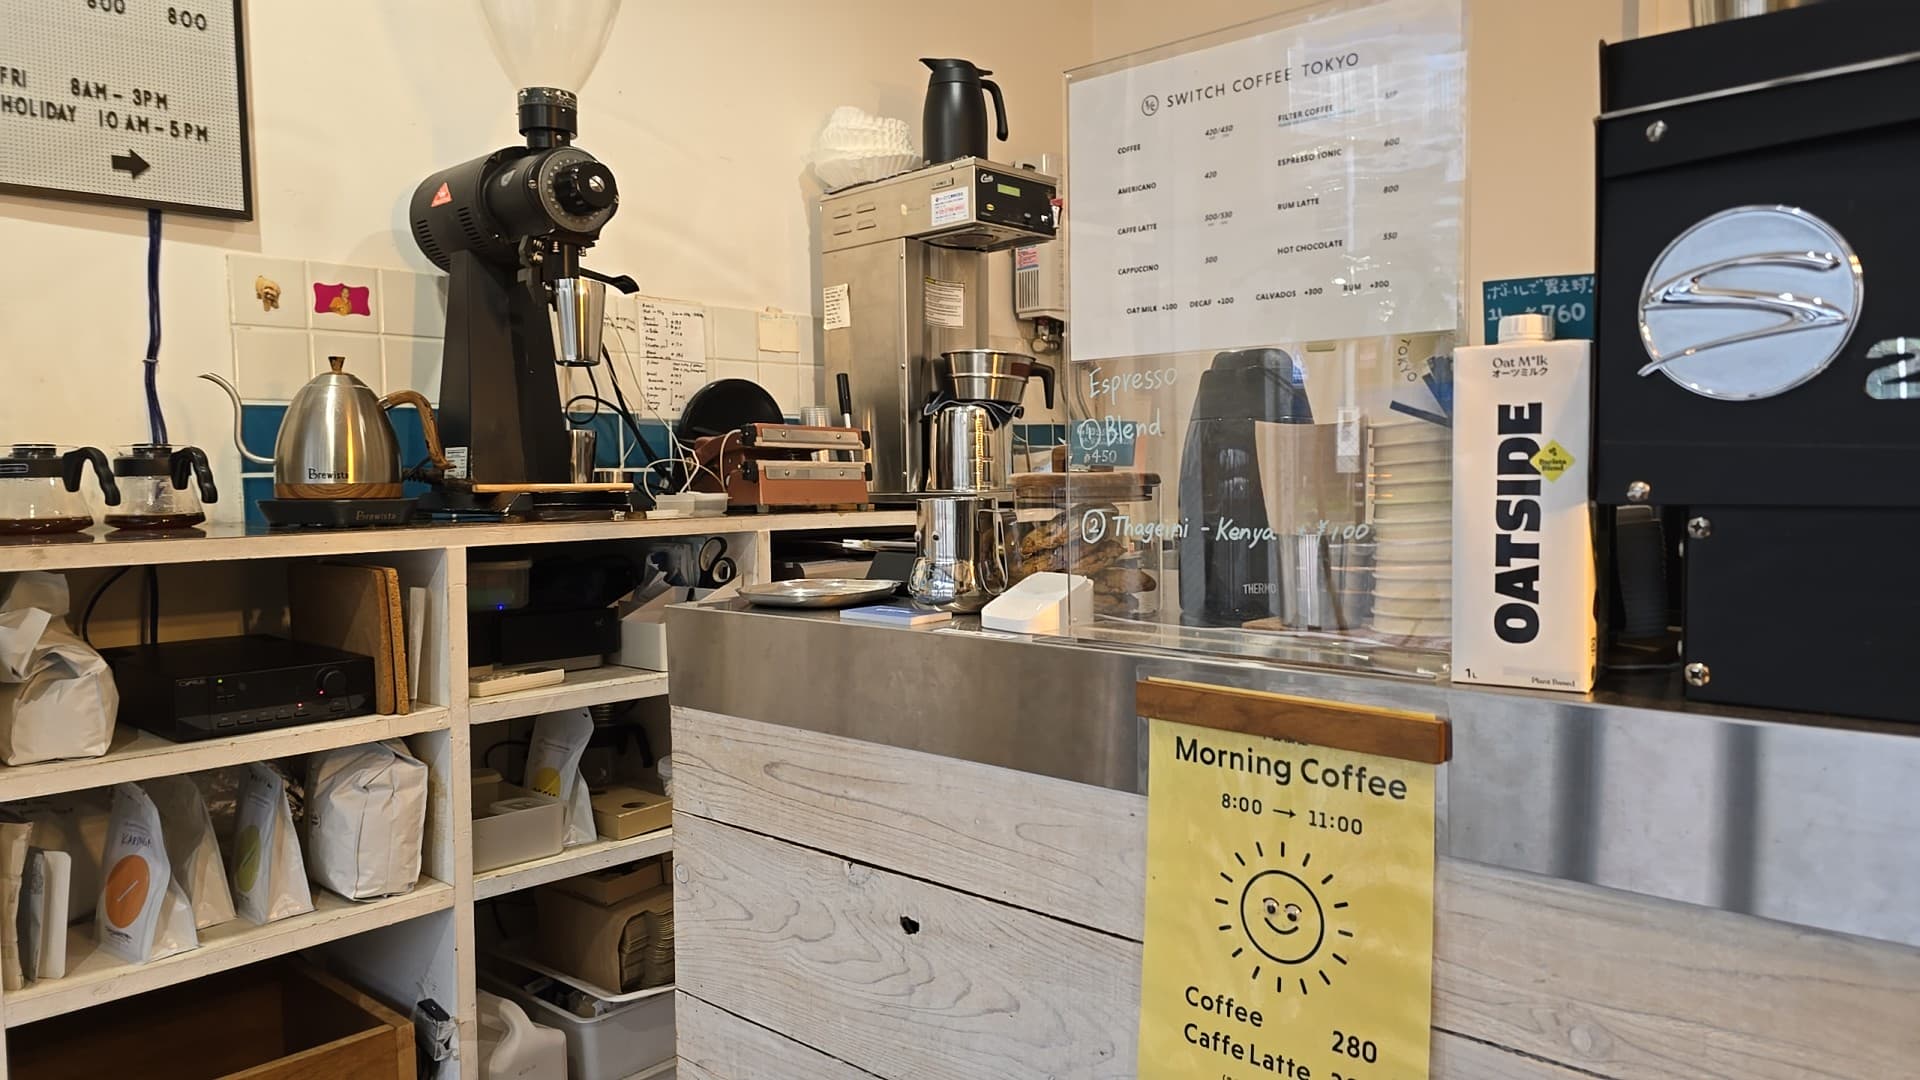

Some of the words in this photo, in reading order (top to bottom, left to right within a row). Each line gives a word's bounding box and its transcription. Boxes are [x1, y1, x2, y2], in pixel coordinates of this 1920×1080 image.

[168, 7, 207, 31] 800
[0, 66, 26, 88] FRI
[1167, 83, 1226, 108] SWITCH
[1232, 67, 1293, 94] COFFEE
[1301, 52, 1359, 77] TOKYO
[0, 95, 77, 123] HOLIDAY
[1278, 111, 1303, 123] FILTER
[1304, 104, 1334, 117] COFFEE
[1117, 143, 1141, 155] COFFEE
[1277, 153, 1316, 168] ESPRESSO
[1317, 148, 1343, 161] TONIC
[1117, 182, 1157, 196] AMERICANO
[1277, 202, 1295, 211] RUM
[1297, 197, 1320, 208] LATTE
[1117, 225, 1137, 236] CAFFE
[1138, 222, 1158, 233] LATTE
[1277, 246, 1294, 256] HOT
[1295, 239, 1344, 254] CHOCOLATE
[1117, 263, 1160, 277] CAPPUCCINO
[1141, 305, 1158, 313] MILK
[1189, 299, 1212, 308] DECAF
[1255, 290, 1297, 301] CALVADOS
[1343, 283, 1362, 292] RUM
[1397, 338, 1418, 382] TOKYO
[1492, 357, 1516, 369] Oat
[1492, 366, 1549, 378] オーツミルク
[1089, 367, 1178, 406] Espresso
[1104, 407, 1163, 447] Blend
[308, 468, 349, 481] Brewista
[355, 510, 397, 522] Brewista
[1494, 402, 1542, 644] OATSIDE
[1215, 516, 1277, 549] Kenya
[1174, 736, 1292, 786] Morning
[1300, 758, 1408, 801] Coffee
[1221, 793, 1263, 815] 8:00
[1308, 810, 1363, 836] 11:00
[1184, 985, 1264, 1028] Coffee
[1183, 1022, 1245, 1060] Caffe
[1249, 1043, 1311, 1080] Latte
[1331, 1030, 1378, 1063] 280
